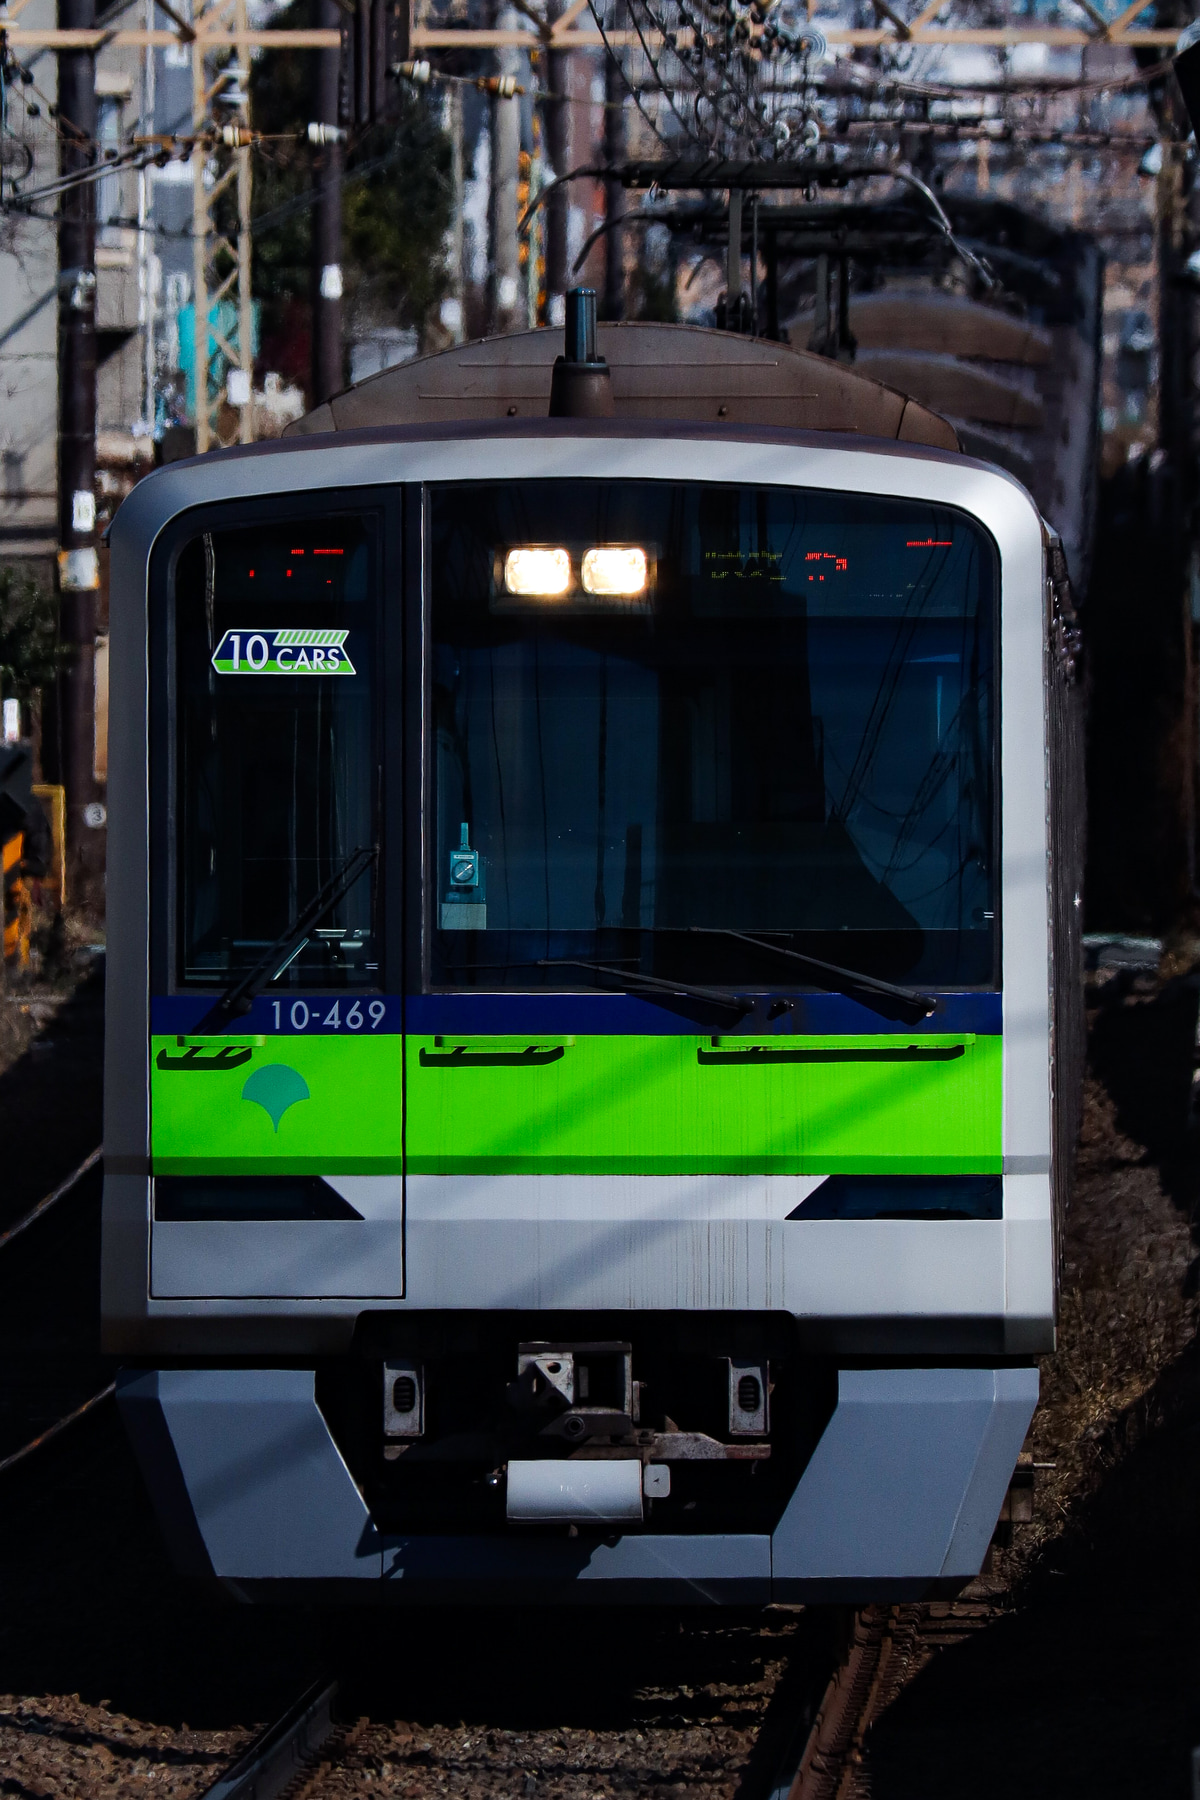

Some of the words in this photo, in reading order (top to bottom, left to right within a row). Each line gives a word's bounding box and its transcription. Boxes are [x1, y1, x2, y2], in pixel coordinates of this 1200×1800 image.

[229, 635, 269, 670] 10
[276, 648, 340, 671] CARS
[272, 1000, 386, 1030] 10-469
